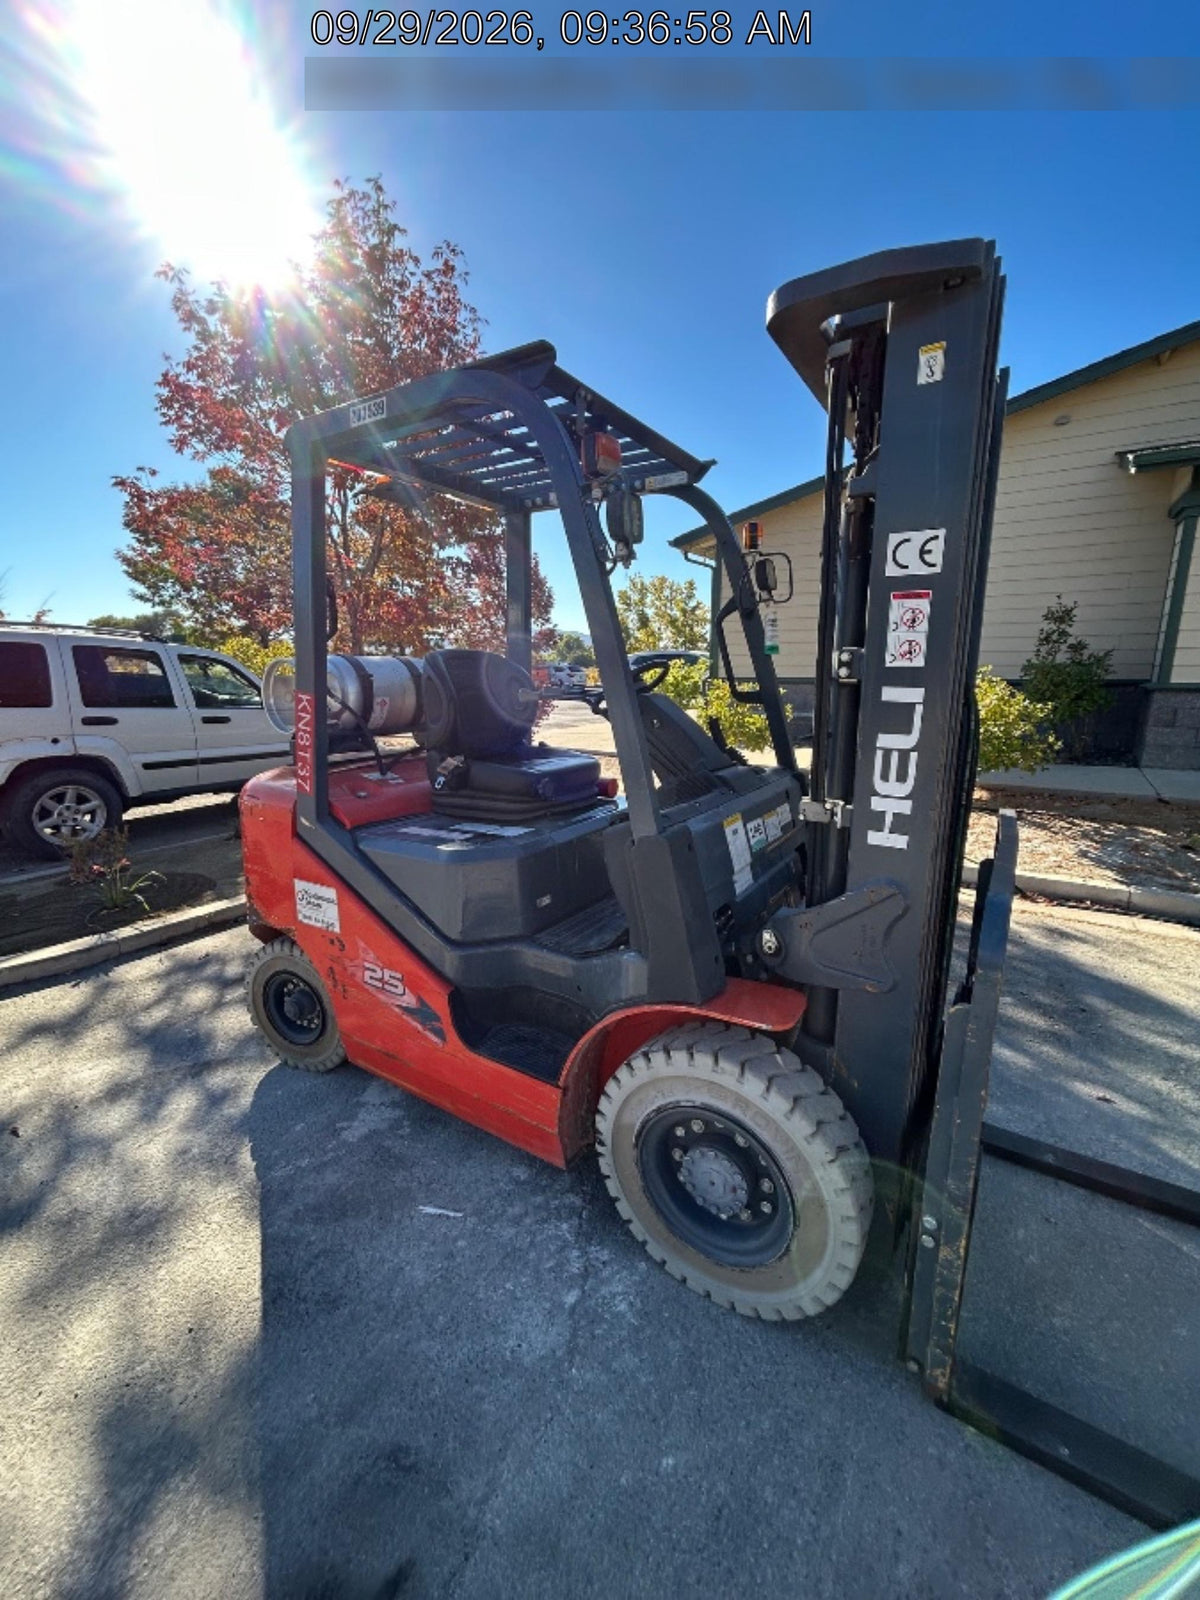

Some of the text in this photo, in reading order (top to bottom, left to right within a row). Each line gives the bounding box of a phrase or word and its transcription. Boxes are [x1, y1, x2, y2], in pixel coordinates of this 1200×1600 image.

[892, 535, 940, 570] CE
[867, 686, 925, 850] HELI
[363, 961, 407, 997] 25
